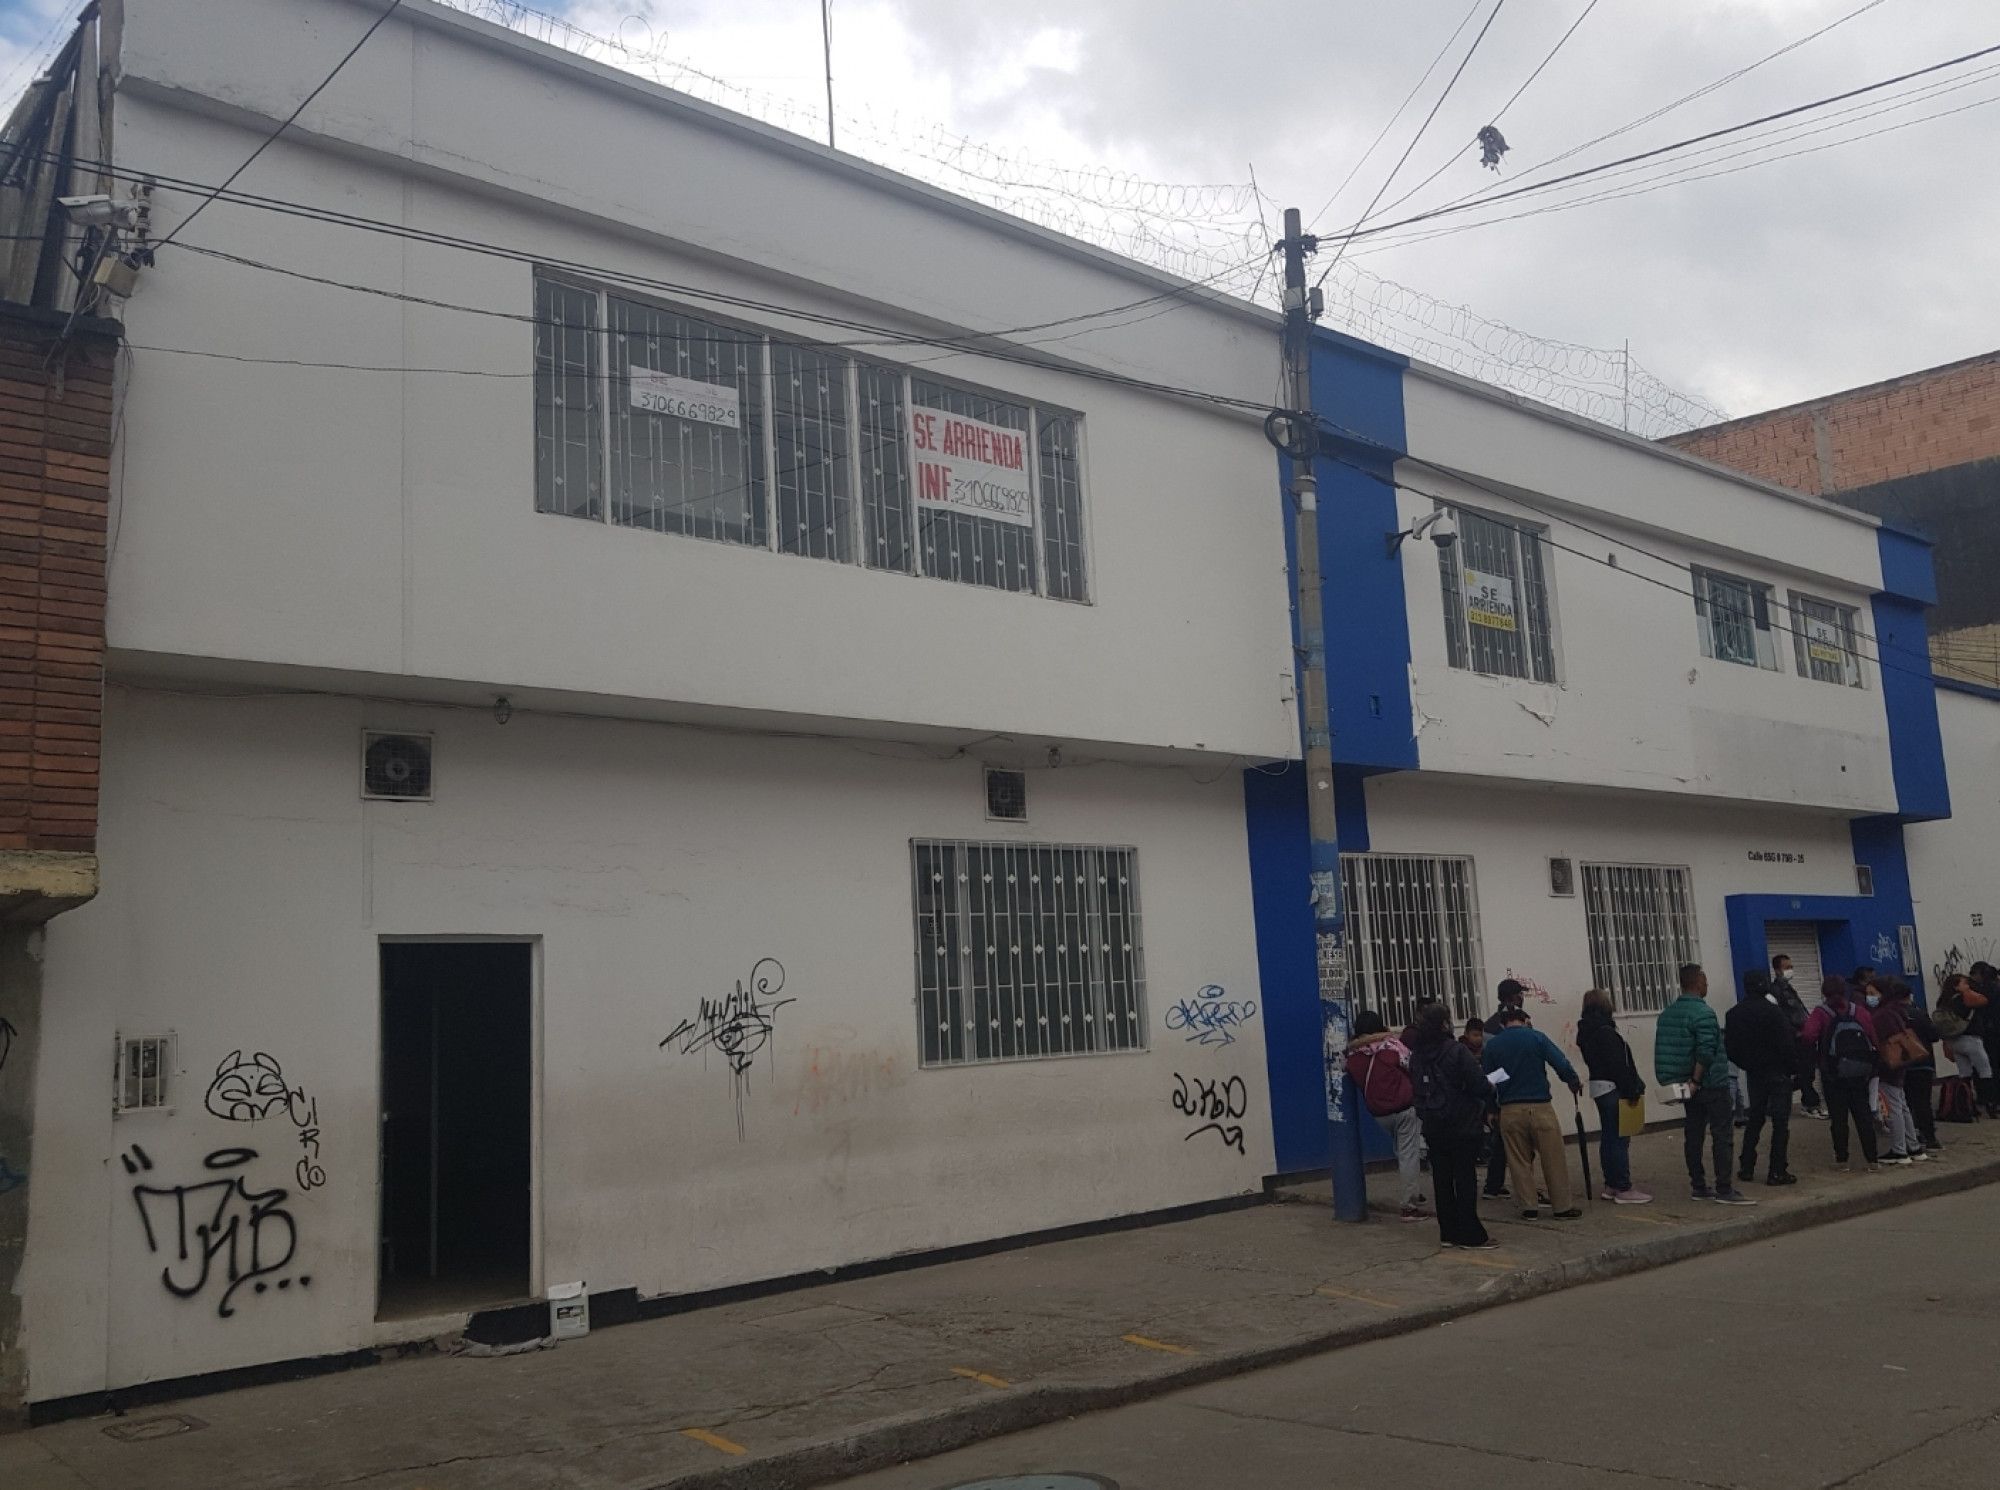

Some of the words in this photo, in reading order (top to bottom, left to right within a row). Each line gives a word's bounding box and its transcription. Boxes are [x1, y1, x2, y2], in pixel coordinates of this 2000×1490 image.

[641, 392, 736, 426] 3106669829
[914, 413, 938, 452] SE
[943, 419, 1024, 472] ARRIENDA
[1481, 586, 1498, 601] SE
[1469, 595, 1513, 619] ARRIENDA
[1748, 851, 1763, 861] Calle
